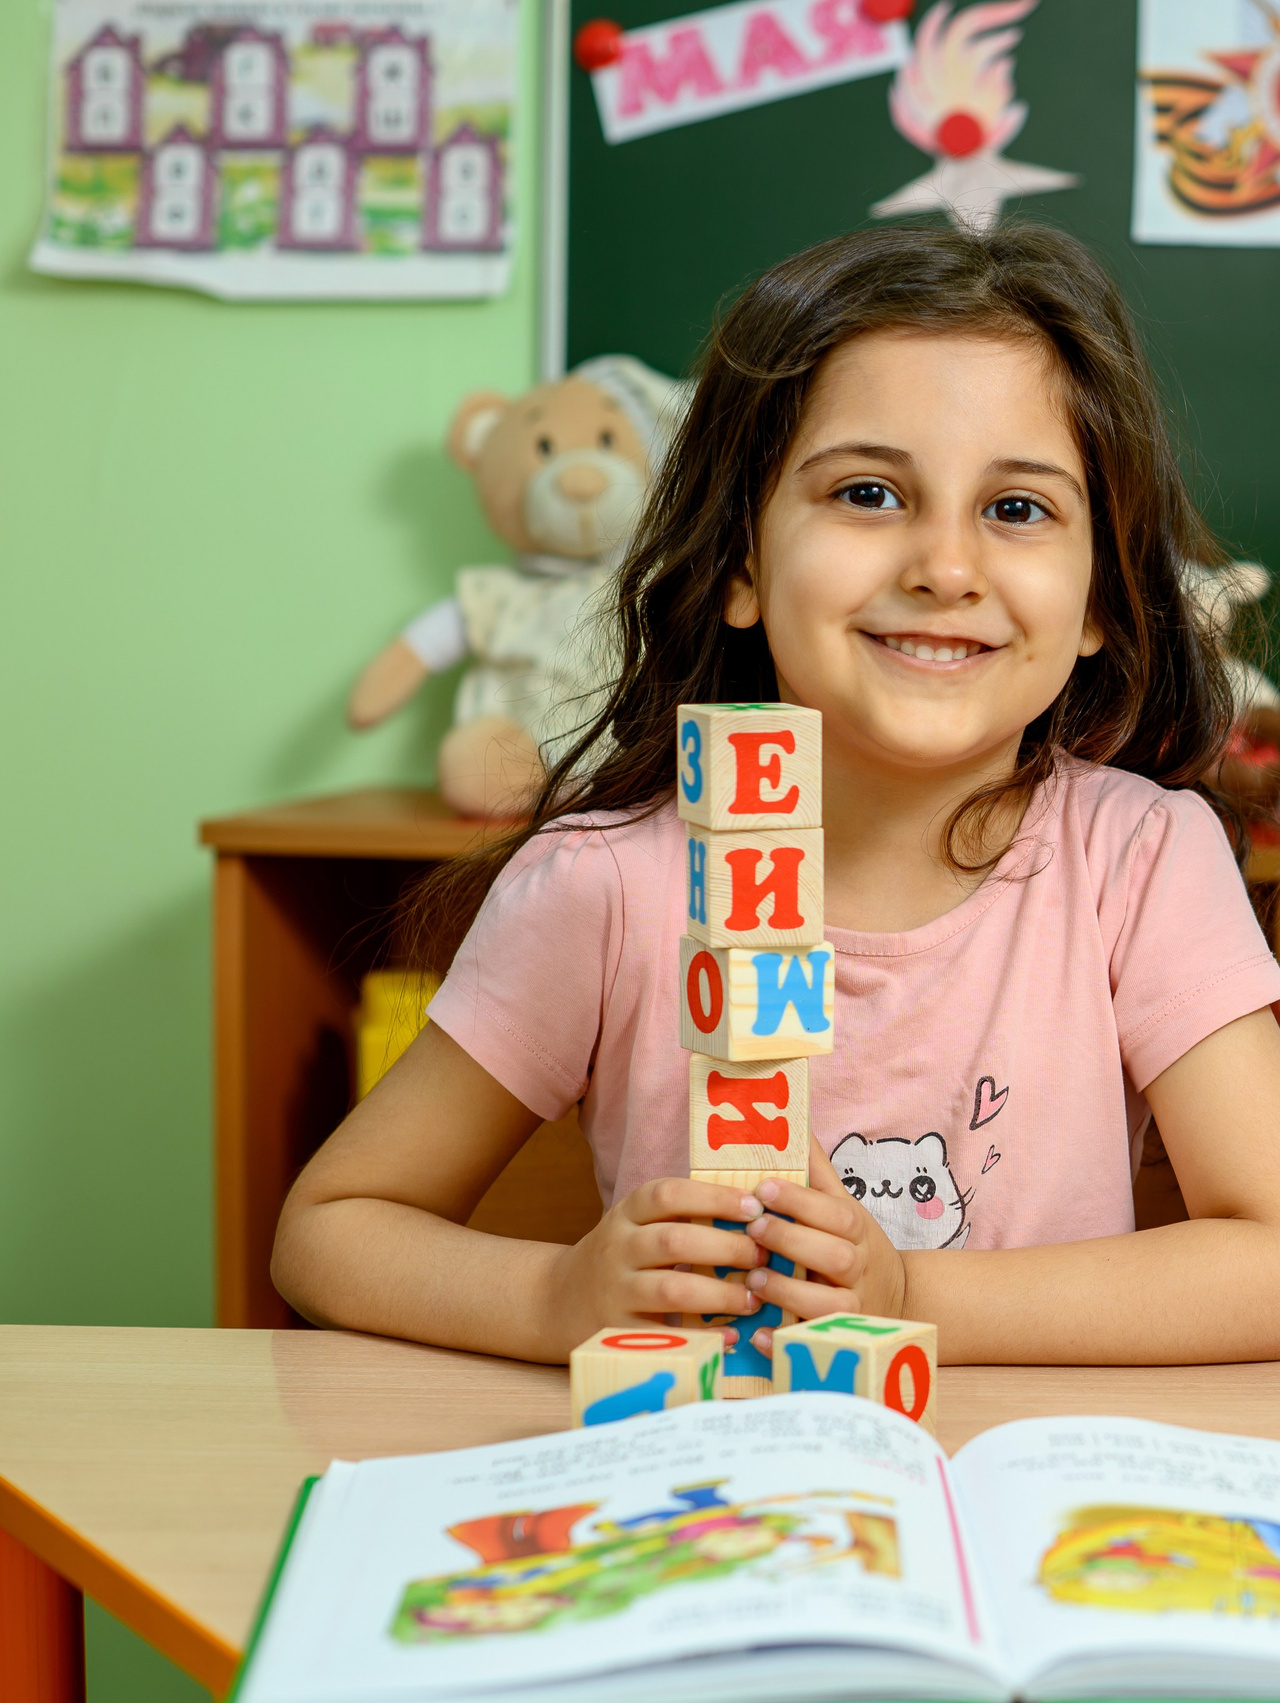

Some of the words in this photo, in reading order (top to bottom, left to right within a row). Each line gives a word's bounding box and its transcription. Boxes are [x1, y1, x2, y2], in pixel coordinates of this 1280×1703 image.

[616, 0, 889, 119] МАЯ
[727, 730, 800, 814] Е
[688, 837, 707, 925] Н
[724, 847, 805, 931] И
